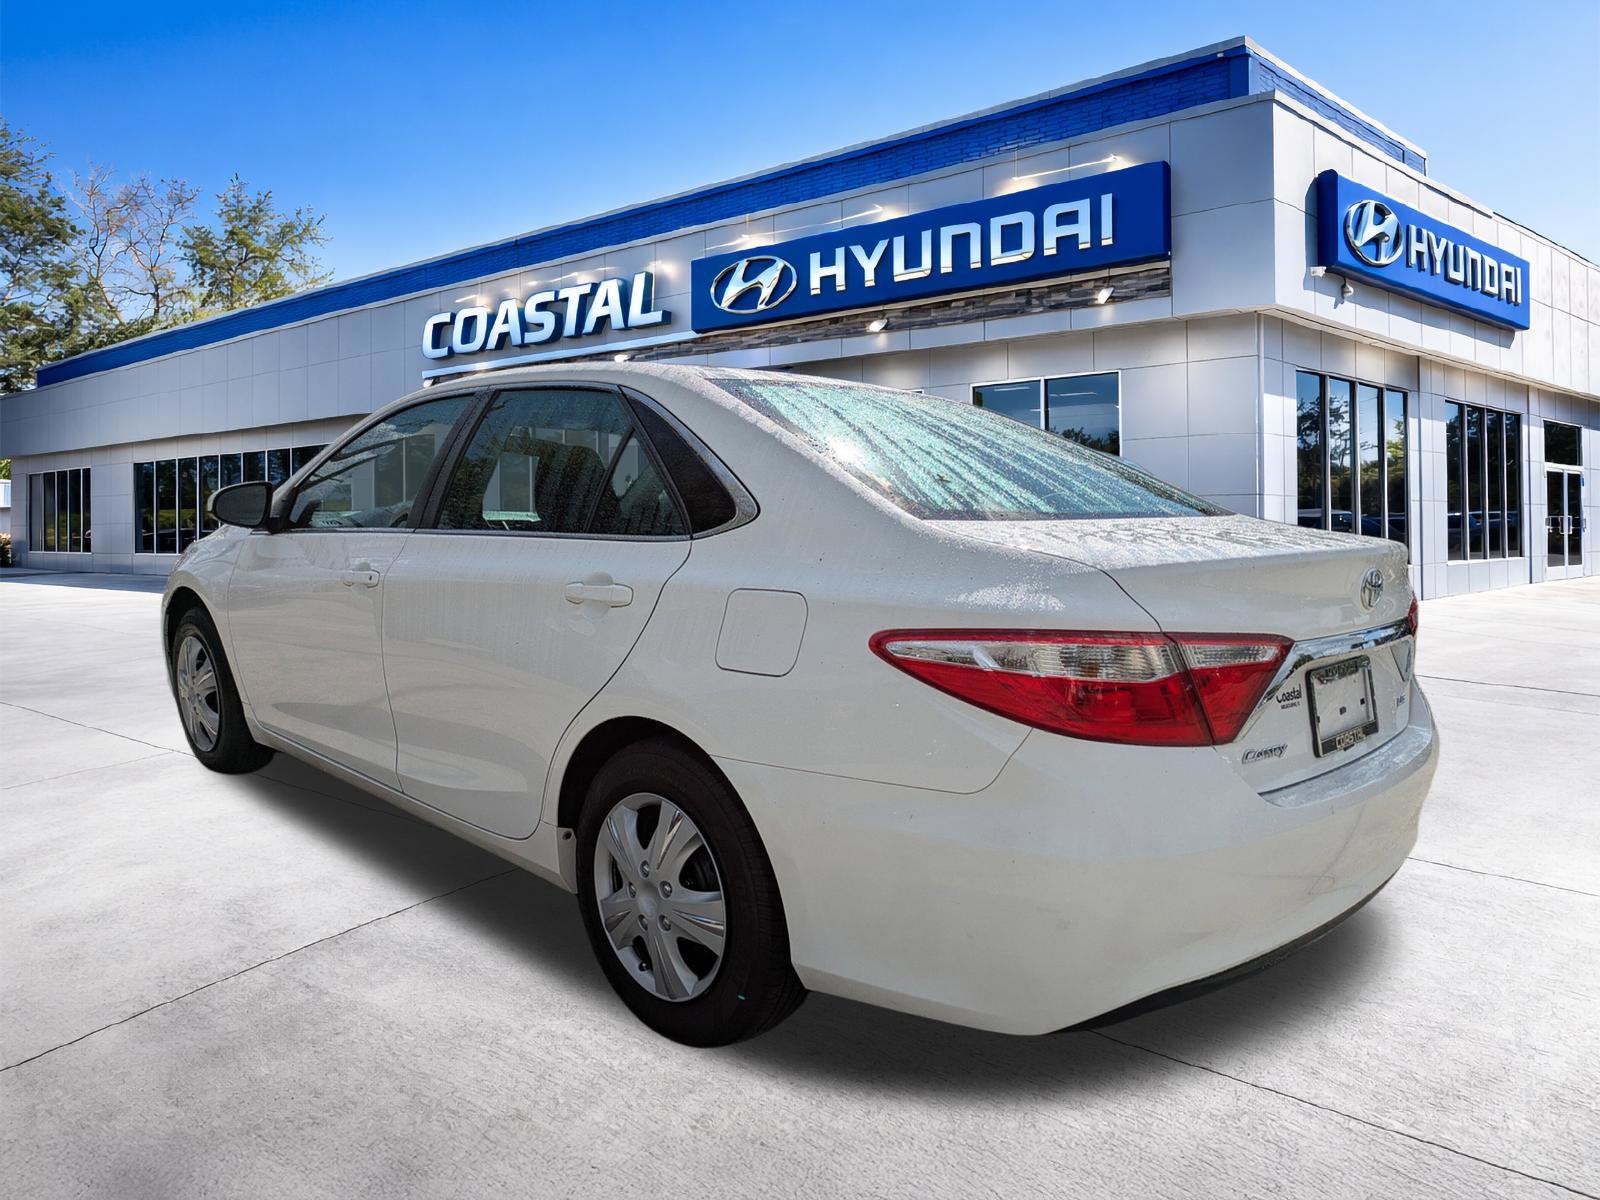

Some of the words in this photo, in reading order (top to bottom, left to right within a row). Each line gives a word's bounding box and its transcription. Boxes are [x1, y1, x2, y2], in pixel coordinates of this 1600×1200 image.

[809, 192, 1114, 296] HYUNDAI
[1406, 223, 1522, 306] HYUNDAI
[422, 271, 668, 360] COASTAL
